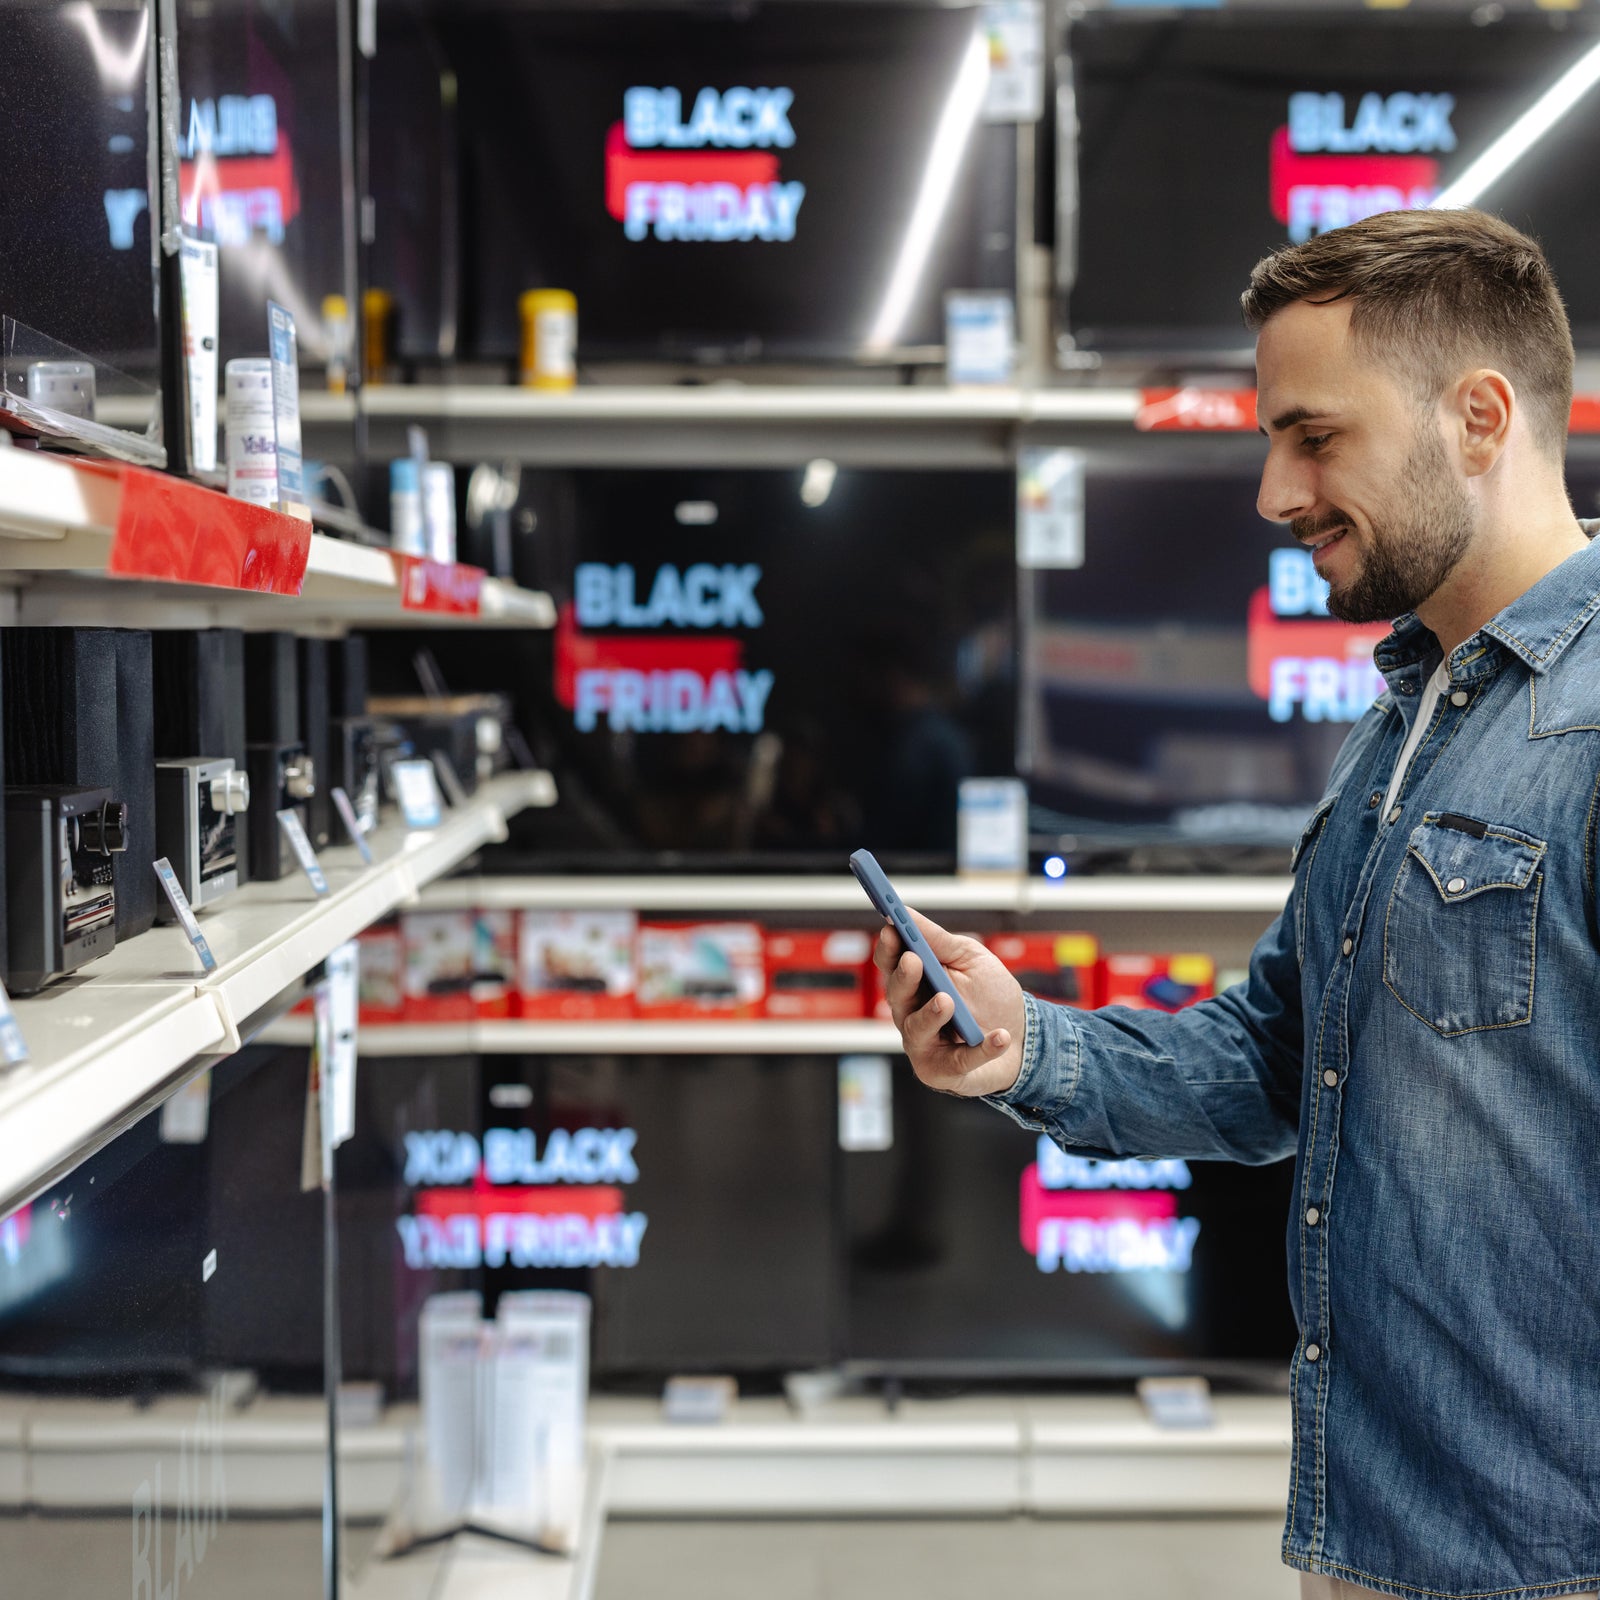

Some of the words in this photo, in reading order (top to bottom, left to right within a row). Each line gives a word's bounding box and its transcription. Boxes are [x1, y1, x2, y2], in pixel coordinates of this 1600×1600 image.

[624, 87, 796, 148] BLACK
[1288, 92, 1458, 153] BLACK
[624, 181, 806, 242] FRIDAY
[575, 563, 763, 628] BLACK
[575, 669, 774, 733] FRIDAY
[1268, 656, 1389, 722] FRI
[484, 1127, 640, 1184] BLACK
[484, 1212, 649, 1268] FRIDAY
[1036, 1216, 1201, 1273] FRIDAY
